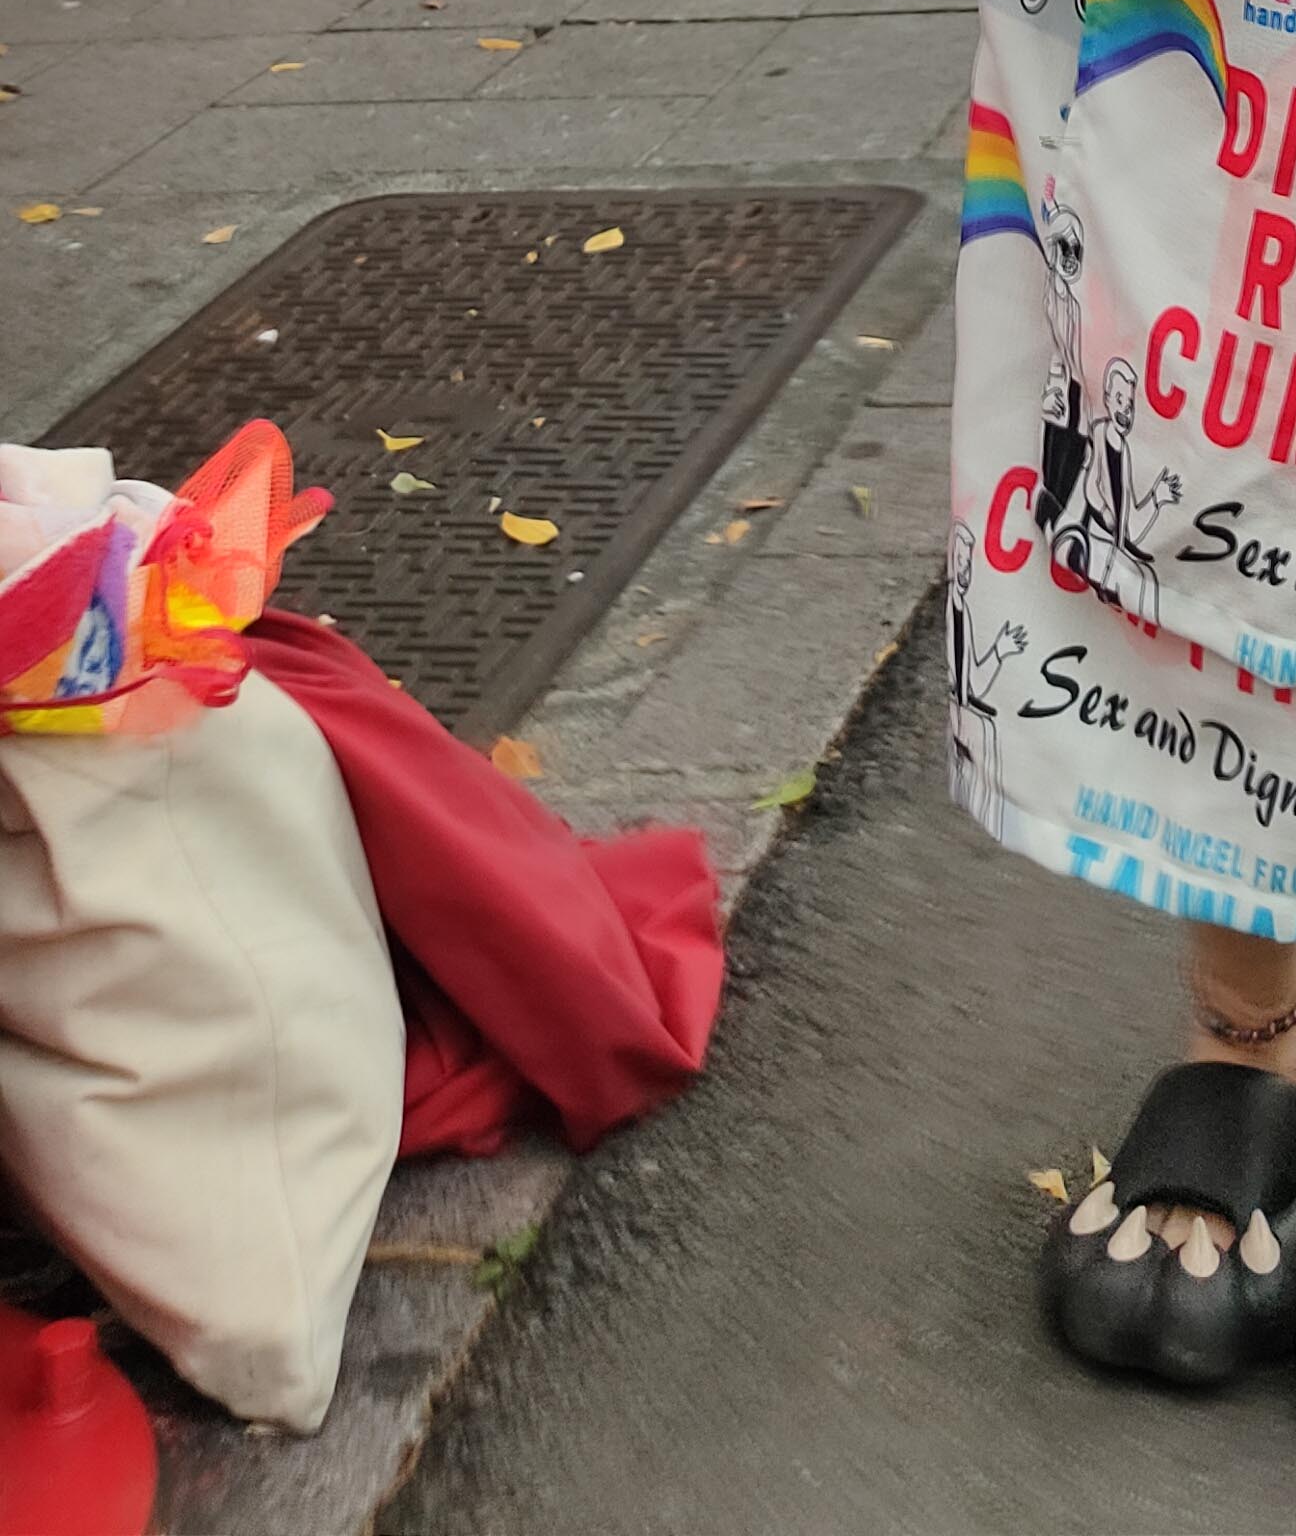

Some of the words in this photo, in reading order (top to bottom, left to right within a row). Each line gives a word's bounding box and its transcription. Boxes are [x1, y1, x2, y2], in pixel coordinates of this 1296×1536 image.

[1175, 501, 1291, 587] Sex
[1017, 644, 1129, 732] Sex
[1133, 705, 1199, 768] and
